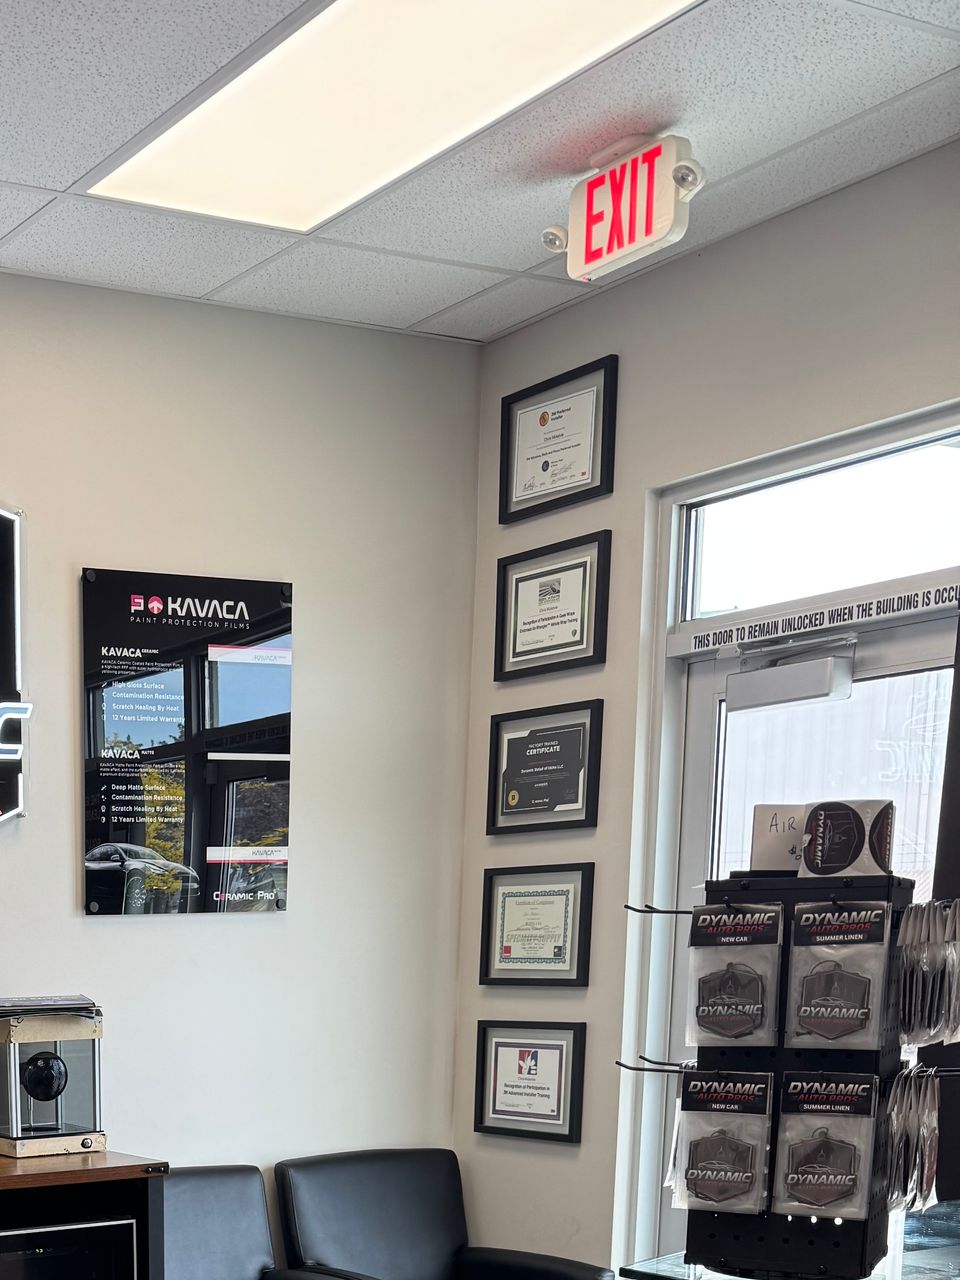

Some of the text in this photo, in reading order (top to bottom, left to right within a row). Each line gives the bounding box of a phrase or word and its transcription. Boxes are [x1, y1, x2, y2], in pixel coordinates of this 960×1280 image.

[584, 143, 662, 265] EXIT
[167, 596, 249, 620] KAVACA
[130, 616, 250, 630] PAINT PROTECTION FILMS
[693, 632, 711, 650] THIS
[712, 628, 733, 646] DOOR
[735, 626, 745, 642] TO
[747, 619, 779, 640] REMAIN
[781, 611, 825, 633] UNLOCKED
[828, 605, 854, 624] WHEN
[856, 601, 874, 619] THE
[876, 592, 919, 616] BUILDING
[921, 590, 931, 607] IS
[101, 646, 142, 658] KAVACA
[112, 691, 153, 699] Contamination
[101, 749, 140, 759] KAVACA
[526, 745, 561, 756] CERTIFICATE
[769, 812, 798, 833] AIR
[814, 811, 825, 868] DYNAMIC
[697, 912, 776, 926] DYNAMIC
[800, 910, 882, 926] DYNAMIC
[706, 924, 765, 933] AUTO PROS
[810, 922, 872, 933] AUTO PROS
[698, 1004, 762, 1016] DYNAMIC
[799, 1006, 868, 1019] DYNAMIC
[688, 1081, 766, 1096] DYNAMIC
[788, 1081, 870, 1096] DYNAMIC
[697, 1093, 755, 1102] AUTO PROS
[798, 1093, 858, 1102] AUTO PROS
[687, 1170, 752, 1183] DYNAMIC
[787, 1174, 856, 1185] DYNAMIC
